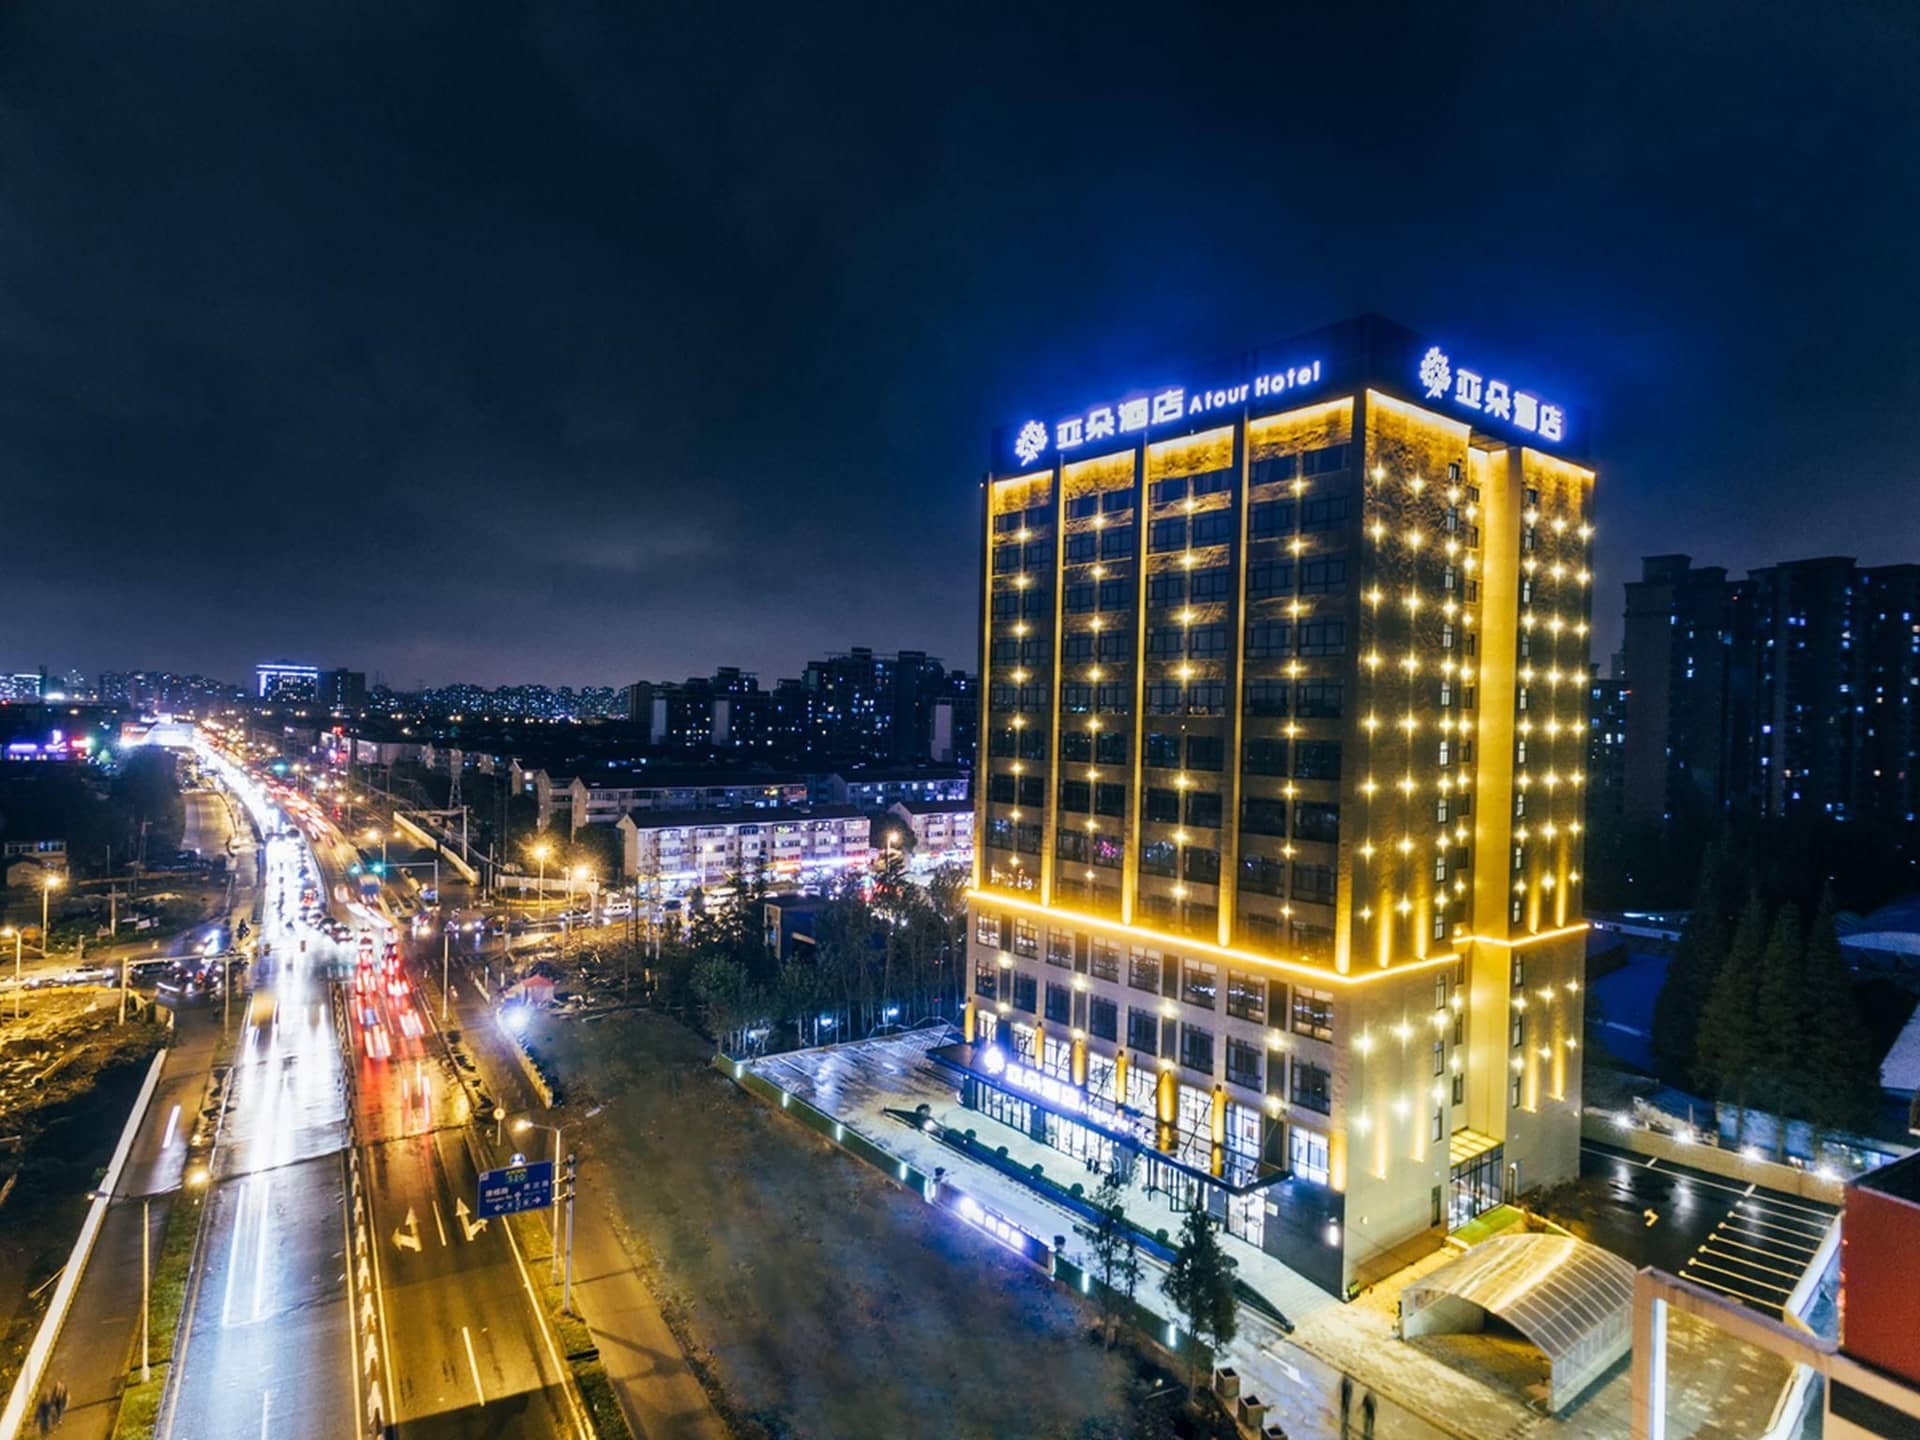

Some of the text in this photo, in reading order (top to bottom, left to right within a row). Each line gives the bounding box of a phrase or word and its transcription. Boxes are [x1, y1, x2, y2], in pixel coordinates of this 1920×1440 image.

[1057, 361, 1320, 449] 亚朵酒店 Atour Hotel
